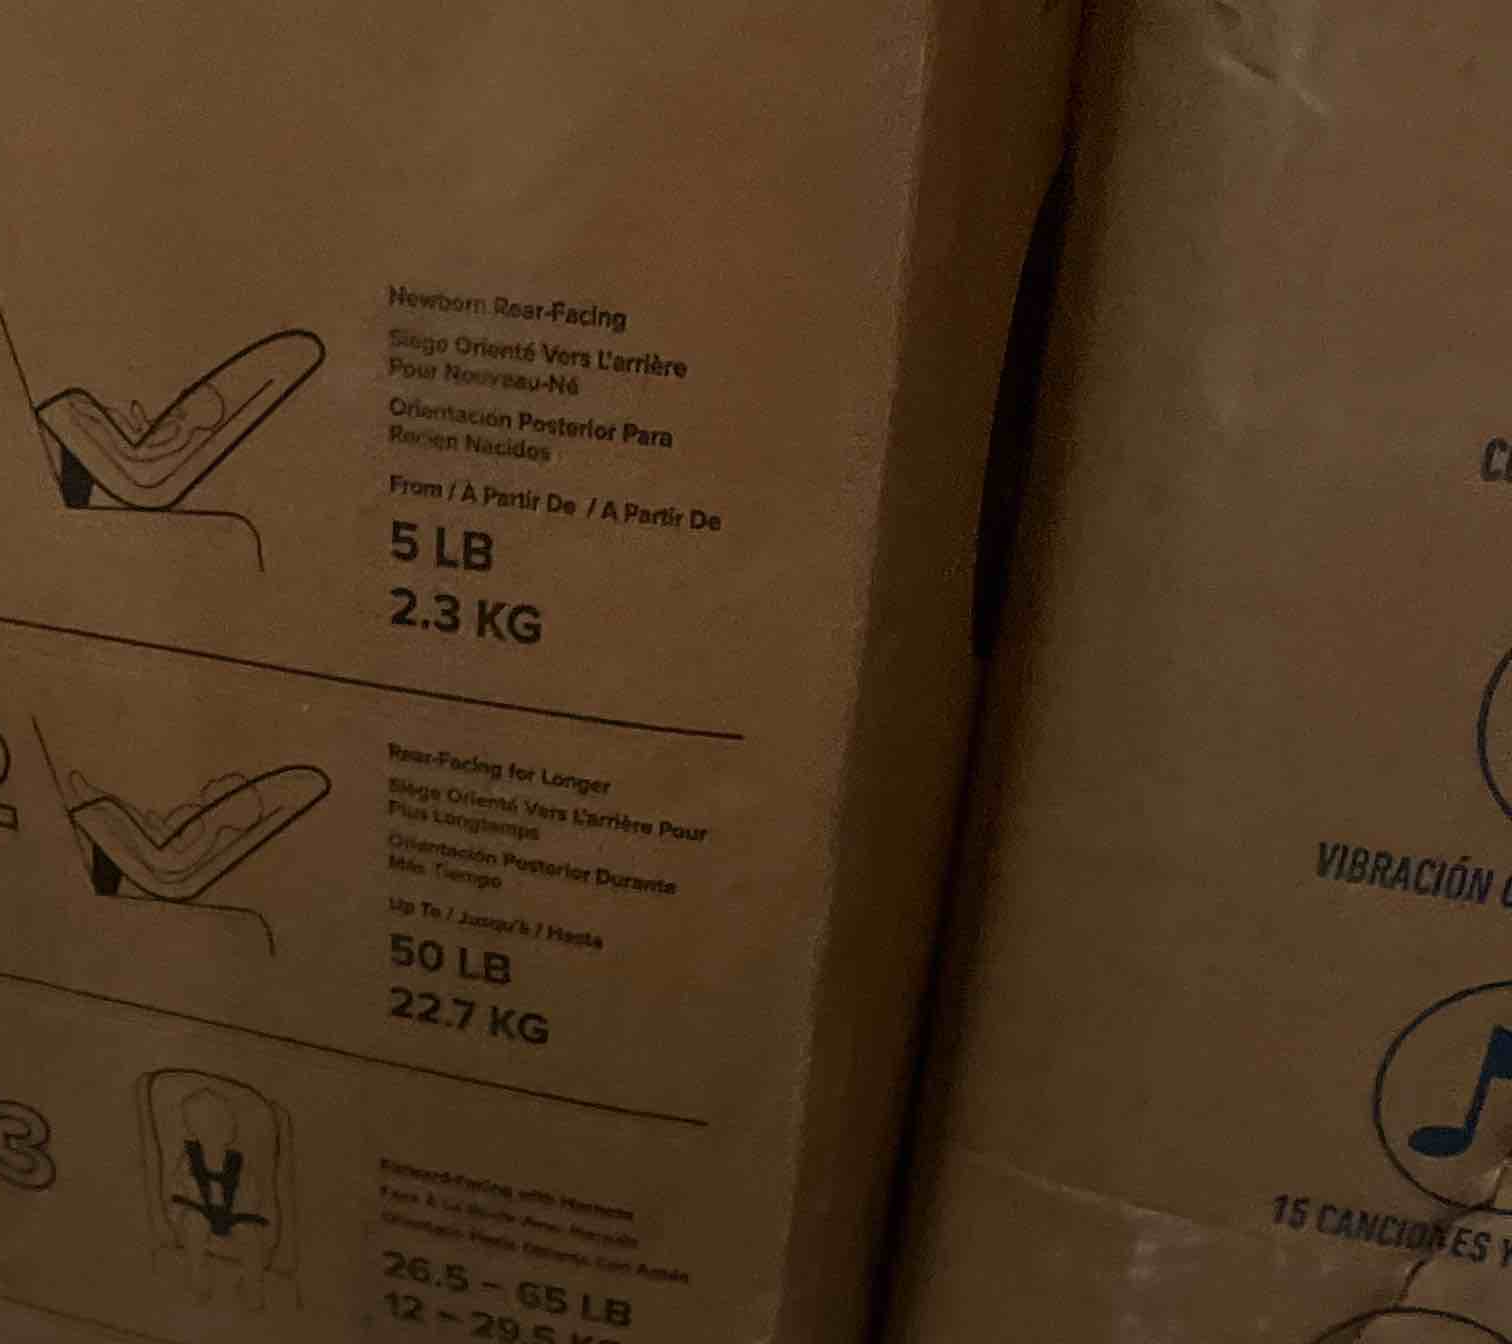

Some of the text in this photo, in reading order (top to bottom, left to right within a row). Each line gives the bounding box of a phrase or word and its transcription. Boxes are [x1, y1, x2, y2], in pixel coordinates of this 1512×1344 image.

[493, 297, 627, 333] Rear-Facing
[543, 344, 590, 369] Vers
[519, 412, 616, 443] Posterior
[624, 424, 673, 450] Para
[390, 475, 442, 499] From
[484, 486, 540, 512] Partir
[547, 494, 576, 516] De
[625, 504, 682, 528] Partir
[690, 509, 721, 532] De
[391, 520, 494, 572] 5 LB
[391, 587, 541, 644] 2.3 KG
[508, 763, 536, 783] for
[541, 769, 611, 796] Longer
[1315, 841, 1494, 905] VIBRACIÓN
[389, 933, 512, 985] 50 LB
[389, 986, 550, 1045] 22.7 KG
[1272, 1194, 1310, 1230] 15
[382, 1250, 469, 1292] 26.5
[582, 1293, 632, 1327] LB
